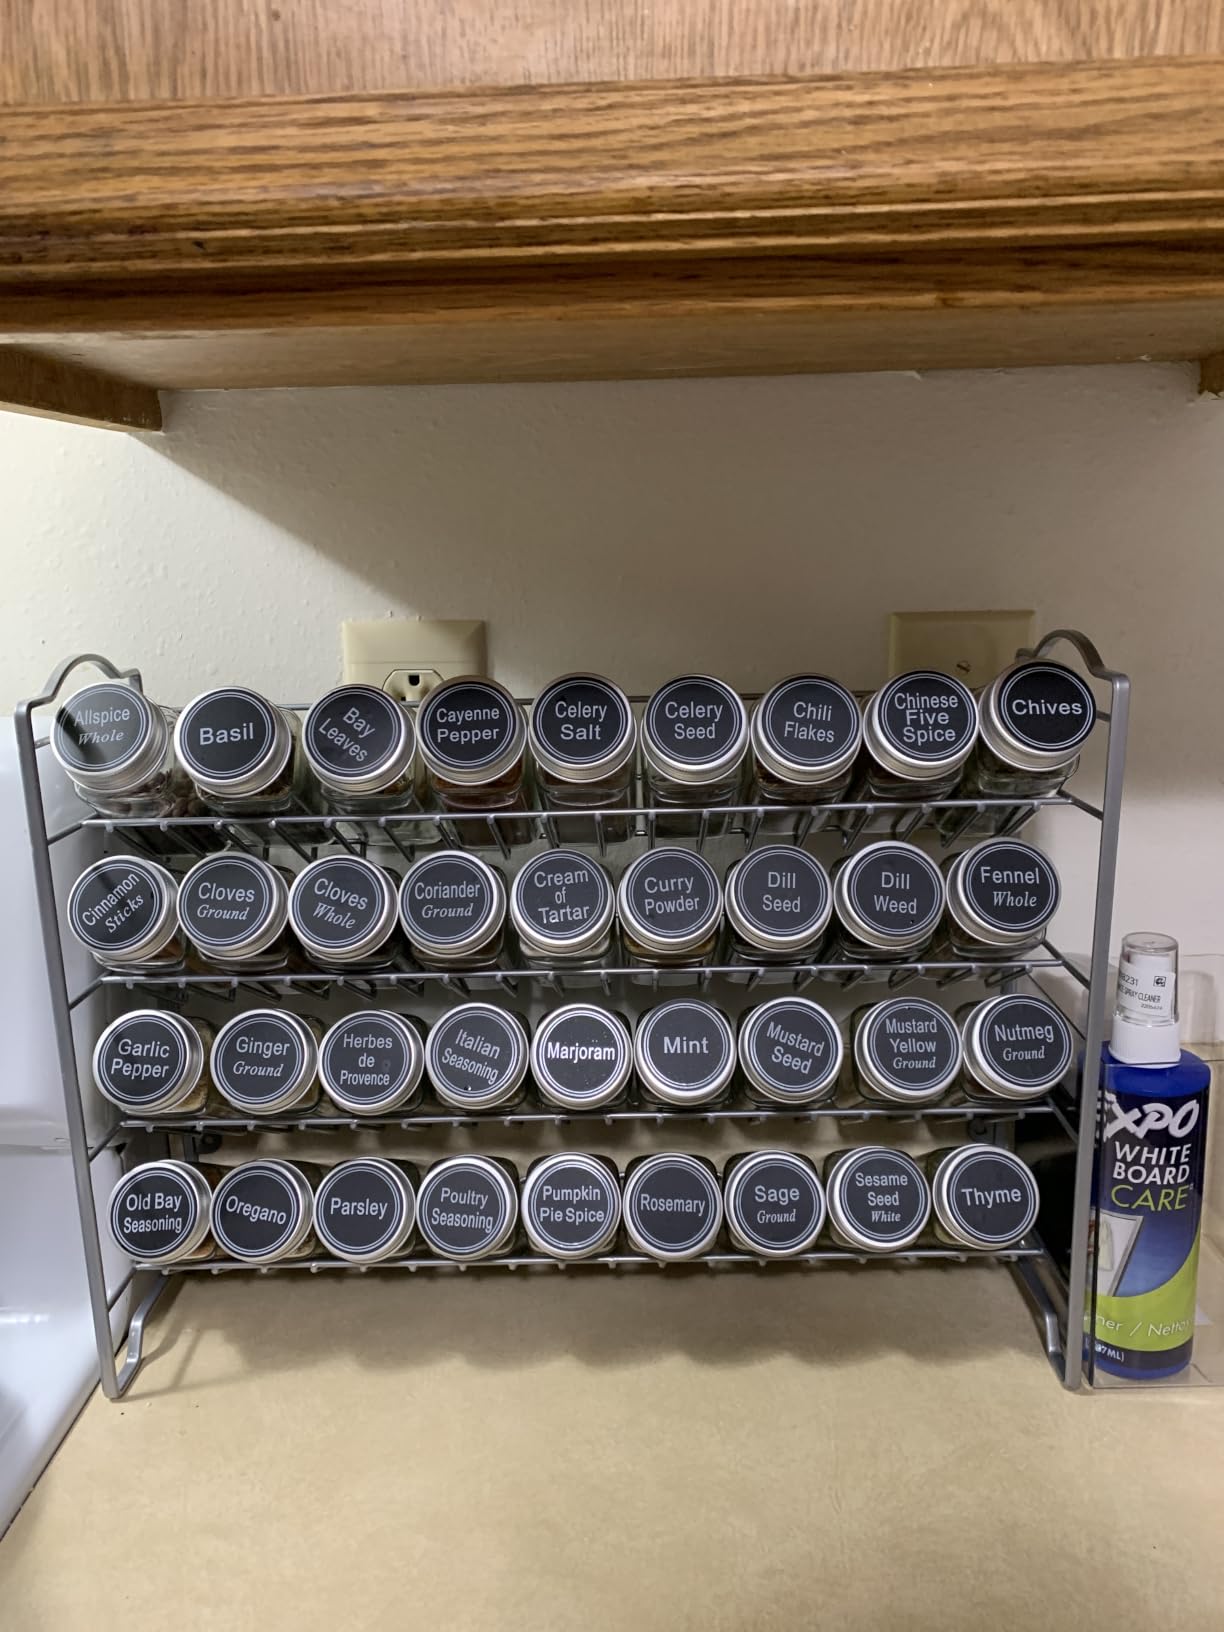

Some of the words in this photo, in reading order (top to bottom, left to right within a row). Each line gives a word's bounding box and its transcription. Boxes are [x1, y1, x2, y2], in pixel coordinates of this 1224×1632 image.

[555, 701, 608, 721] Celery
[665, 701, 723, 721] Celery
[894, 693, 958, 710] Chinese
[1012, 700, 1082, 715] Chives
[73, 707, 130, 727] Allspice
[342, 707, 375, 736] Bay
[436, 706, 500, 725] Cayenne
[793, 702, 832, 722] Chili
[906, 709, 949, 726] Five
[78, 729, 124, 746] Whole
[200, 723, 254, 746] Basil
[318, 718, 368, 762] Leaves
[437, 727, 499, 744] Pepper
[560, 724, 601, 741] Salt
[674, 723, 716, 739] Seed
[784, 722, 835, 743] Flakes
[903, 726, 956, 745] Spice
[534, 870, 589, 888] Cream
[767, 872, 796, 889] Dill
[881, 872, 910, 890] Dill
[980, 866, 1040, 885] Fennel
[198, 882, 255, 903] Cloves
[314, 878, 368, 910] Cloves
[414, 881, 480, 900] Coriander
[644, 876, 694, 895] Curry
[82, 873, 140, 927] Cinnamon
[555, 887, 567, 904] of
[644, 895, 700, 915] Powder
[762, 895, 801, 913] Seed
[873, 895, 917, 915] Weed
[992, 891, 1037, 907] Whole
[105, 893, 144, 933] Sticks
[196, 904, 249, 921] Ground
[312, 902, 356, 929] Whole
[421, 903, 474, 919] Ground
[538, 905, 590, 924] Tartar
[885, 1018, 937, 1034] Mustard
[994, 1024, 1054, 1043] Nutmeg
[118, 1038, 170, 1058] Garlic
[236, 1037, 290, 1059] Ginger
[343, 1033, 393, 1049] Herbes
[455, 1029, 500, 1060] Italian
[663, 1036, 708, 1054] Mint
[766, 1021, 825, 1057] Mustard
[889, 1038, 936, 1053] Yellow
[358, 1052, 375, 1067] de
[547, 1042, 615, 1064] Marjoram
[771, 1046, 812, 1074] Seed
[893, 1056, 936, 1069] Ground
[1002, 1046, 1045, 1062] Ground
[111, 1058, 169, 1080] Pepper
[233, 1061, 284, 1078] Ground
[441, 1047, 499, 1085] Seasoning
[340, 1071, 390, 1086] Provence
[1097, 1090, 1200, 1140] XPO
[1115, 1141, 1192, 1164] WHITE
[855, 1172, 908, 1187] Sesame
[1113, 1163, 1189, 1184] BOARD
[126, 1194, 150, 1211] Old
[154, 1193, 182, 1211] Bay
[440, 1187, 488, 1209] Poultry
[543, 1185, 601, 1204] Pumpkin
[754, 1185, 800, 1203] Sage
[867, 1191, 899, 1206] Seed
[961, 1186, 1022, 1208] Thyme
[1111, 1184, 1189, 1211] CARE
[225, 1196, 286, 1225] Oregano
[330, 1197, 388, 1220] Parsley
[640, 1194, 706, 1217] Rosemary
[124, 1216, 182, 1233] Seasoning
[431, 1208, 494, 1233] Seasoning
[539, 1207, 563, 1222] Pie
[565, 1207, 605, 1225] Spice
[757, 1209, 796, 1223] Ground
[871, 1210, 901, 1223] White
